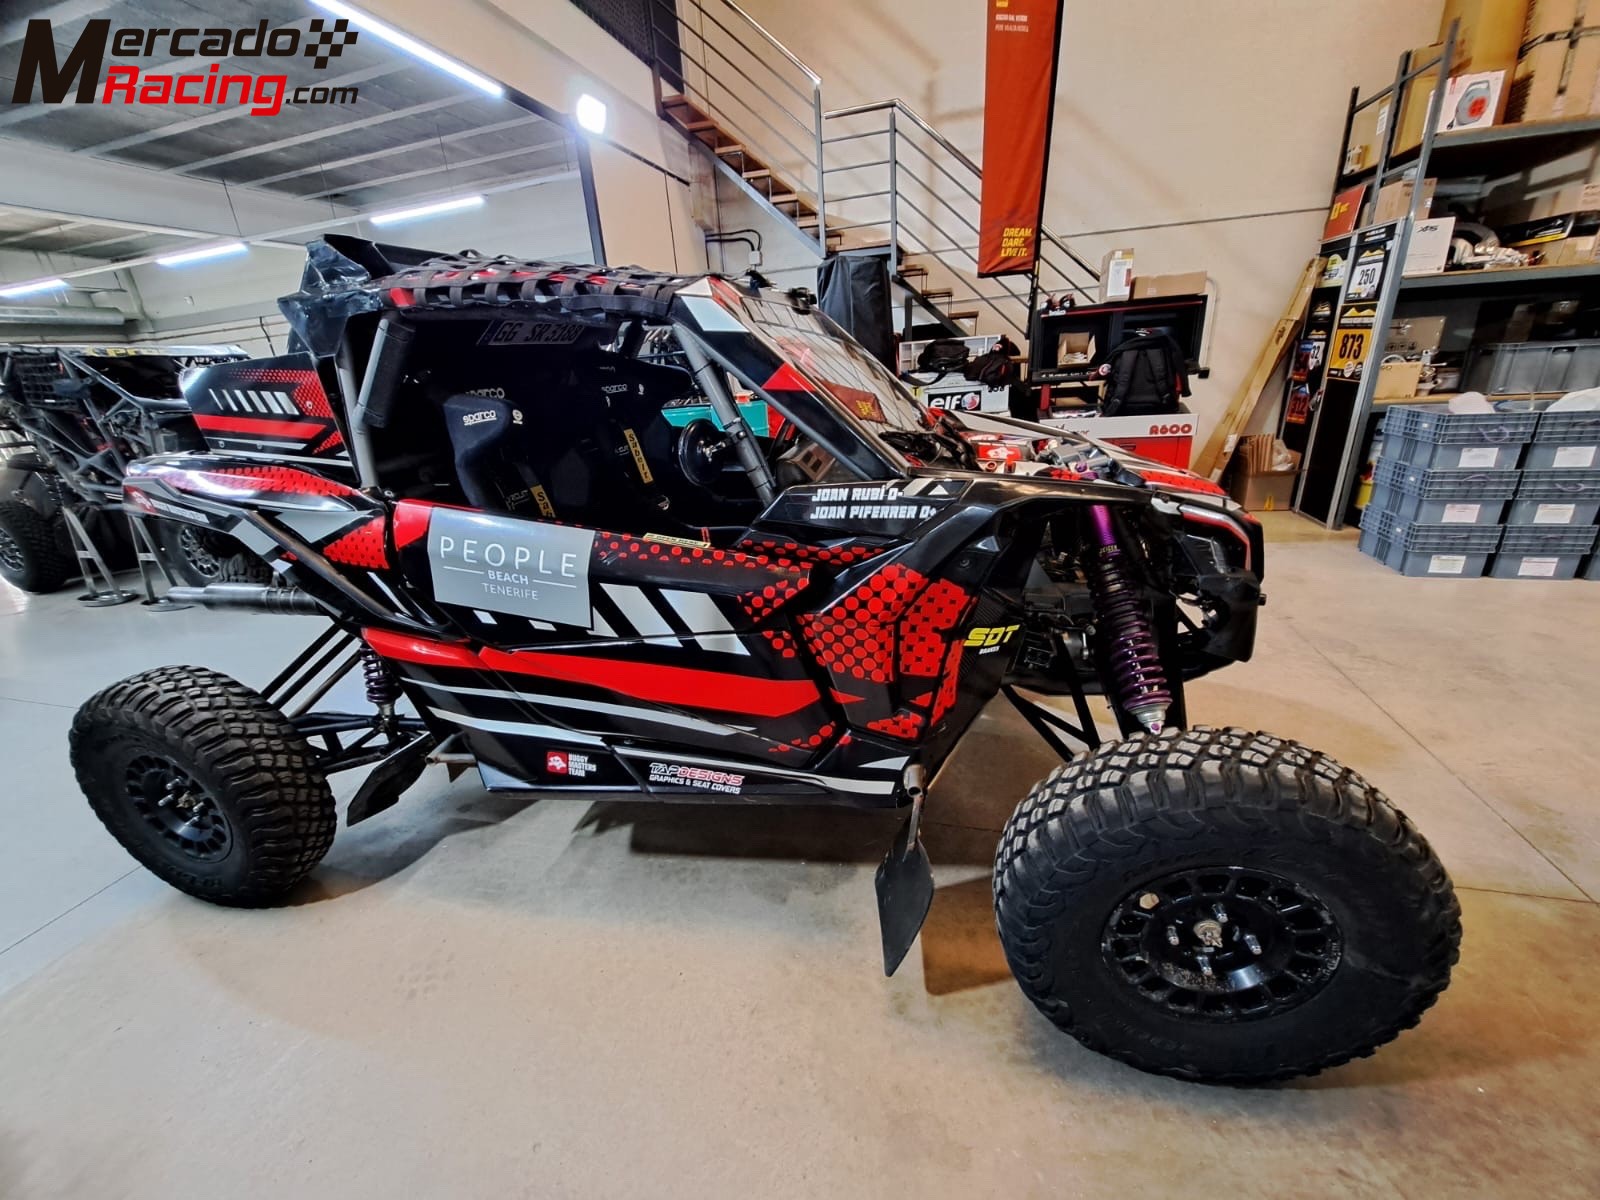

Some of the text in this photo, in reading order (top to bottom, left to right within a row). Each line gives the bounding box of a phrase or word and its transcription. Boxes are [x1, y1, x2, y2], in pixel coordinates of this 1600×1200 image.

[1357, 267, 1376, 286] 250
[494, 321, 522, 343] GG
[1339, 333, 1364, 360] 873
[930, 394, 961, 409] elf
[462, 409, 497, 426] sparco
[1149, 423, 1193, 435] R600
[812, 488, 849, 502] JOAN
[810, 506, 847, 520] JOAN
[849, 505, 918, 520] PIFERRER
[440, 536, 578, 578] PEOPLE
[488, 569, 530, 585] BEACH
[482, 583, 539, 600] TENERIFE
[964, 624, 1021, 647] SDT
[568, 760, 597, 772] MASTERS
[568, 767, 586, 777] TEAM
[649, 774, 741, 795] GRAPHICS & SEAT COVERS
